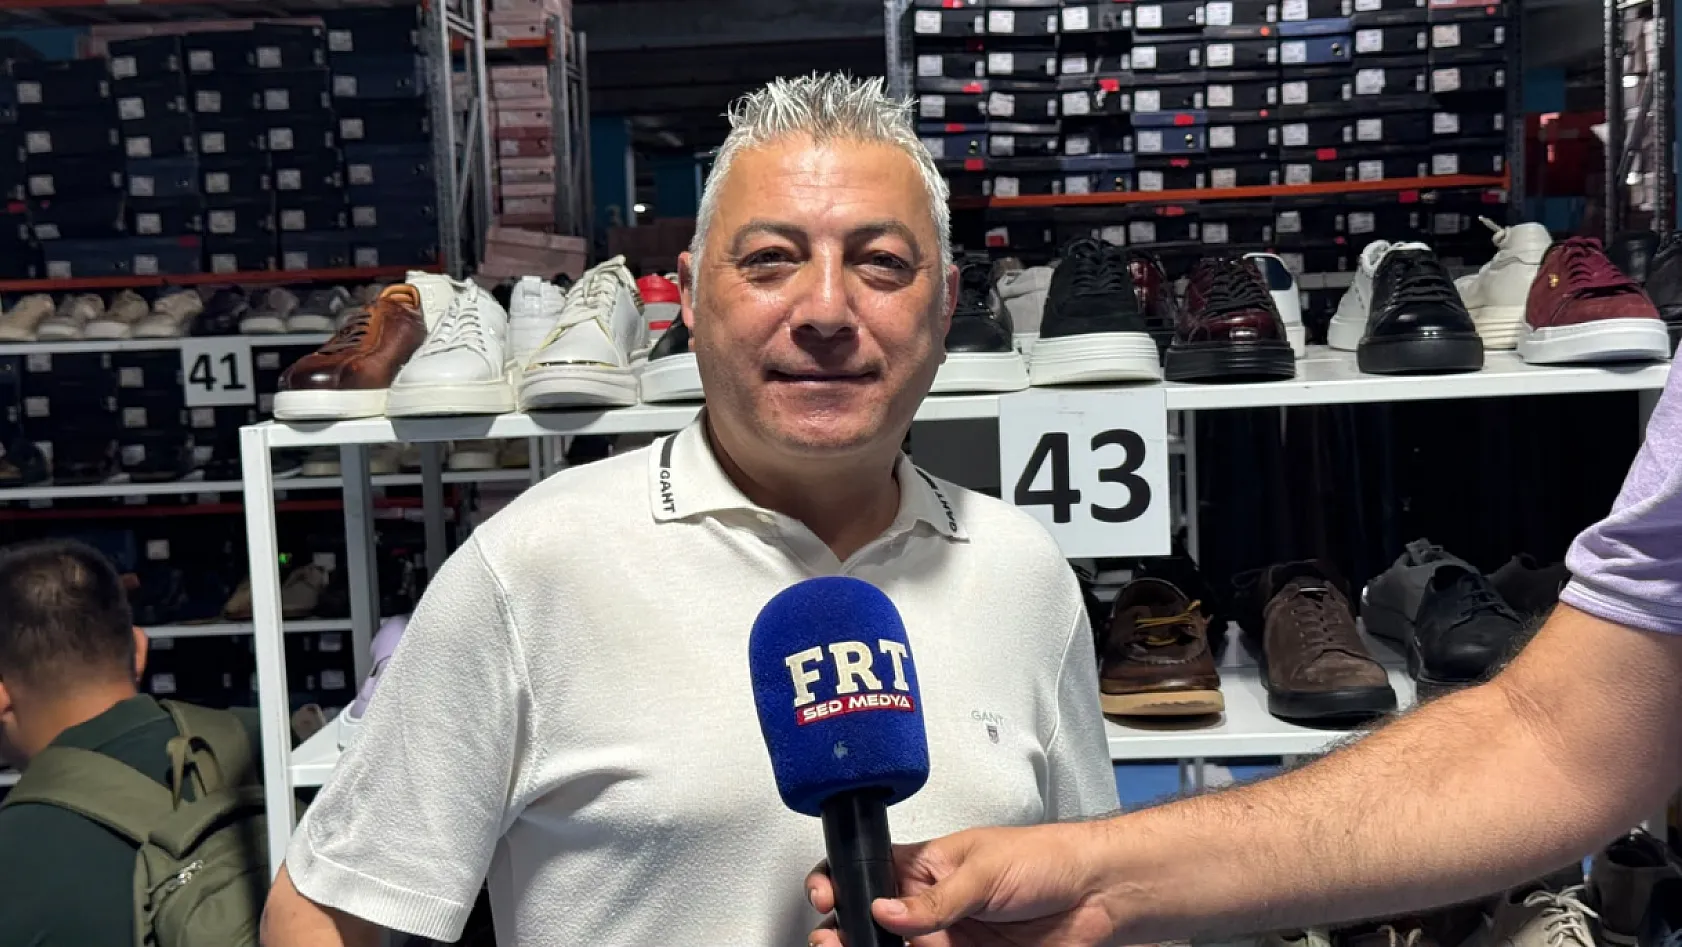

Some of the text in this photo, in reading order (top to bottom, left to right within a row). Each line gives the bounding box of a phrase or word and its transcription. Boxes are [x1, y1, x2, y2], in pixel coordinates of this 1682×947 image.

[189, 352, 247, 392] 41
[1014, 428, 1152, 524] 43
[785, 638, 910, 708] FRT
[803, 693, 911, 721] SED MEDYA
[971, 710, 1004, 726] GANT
